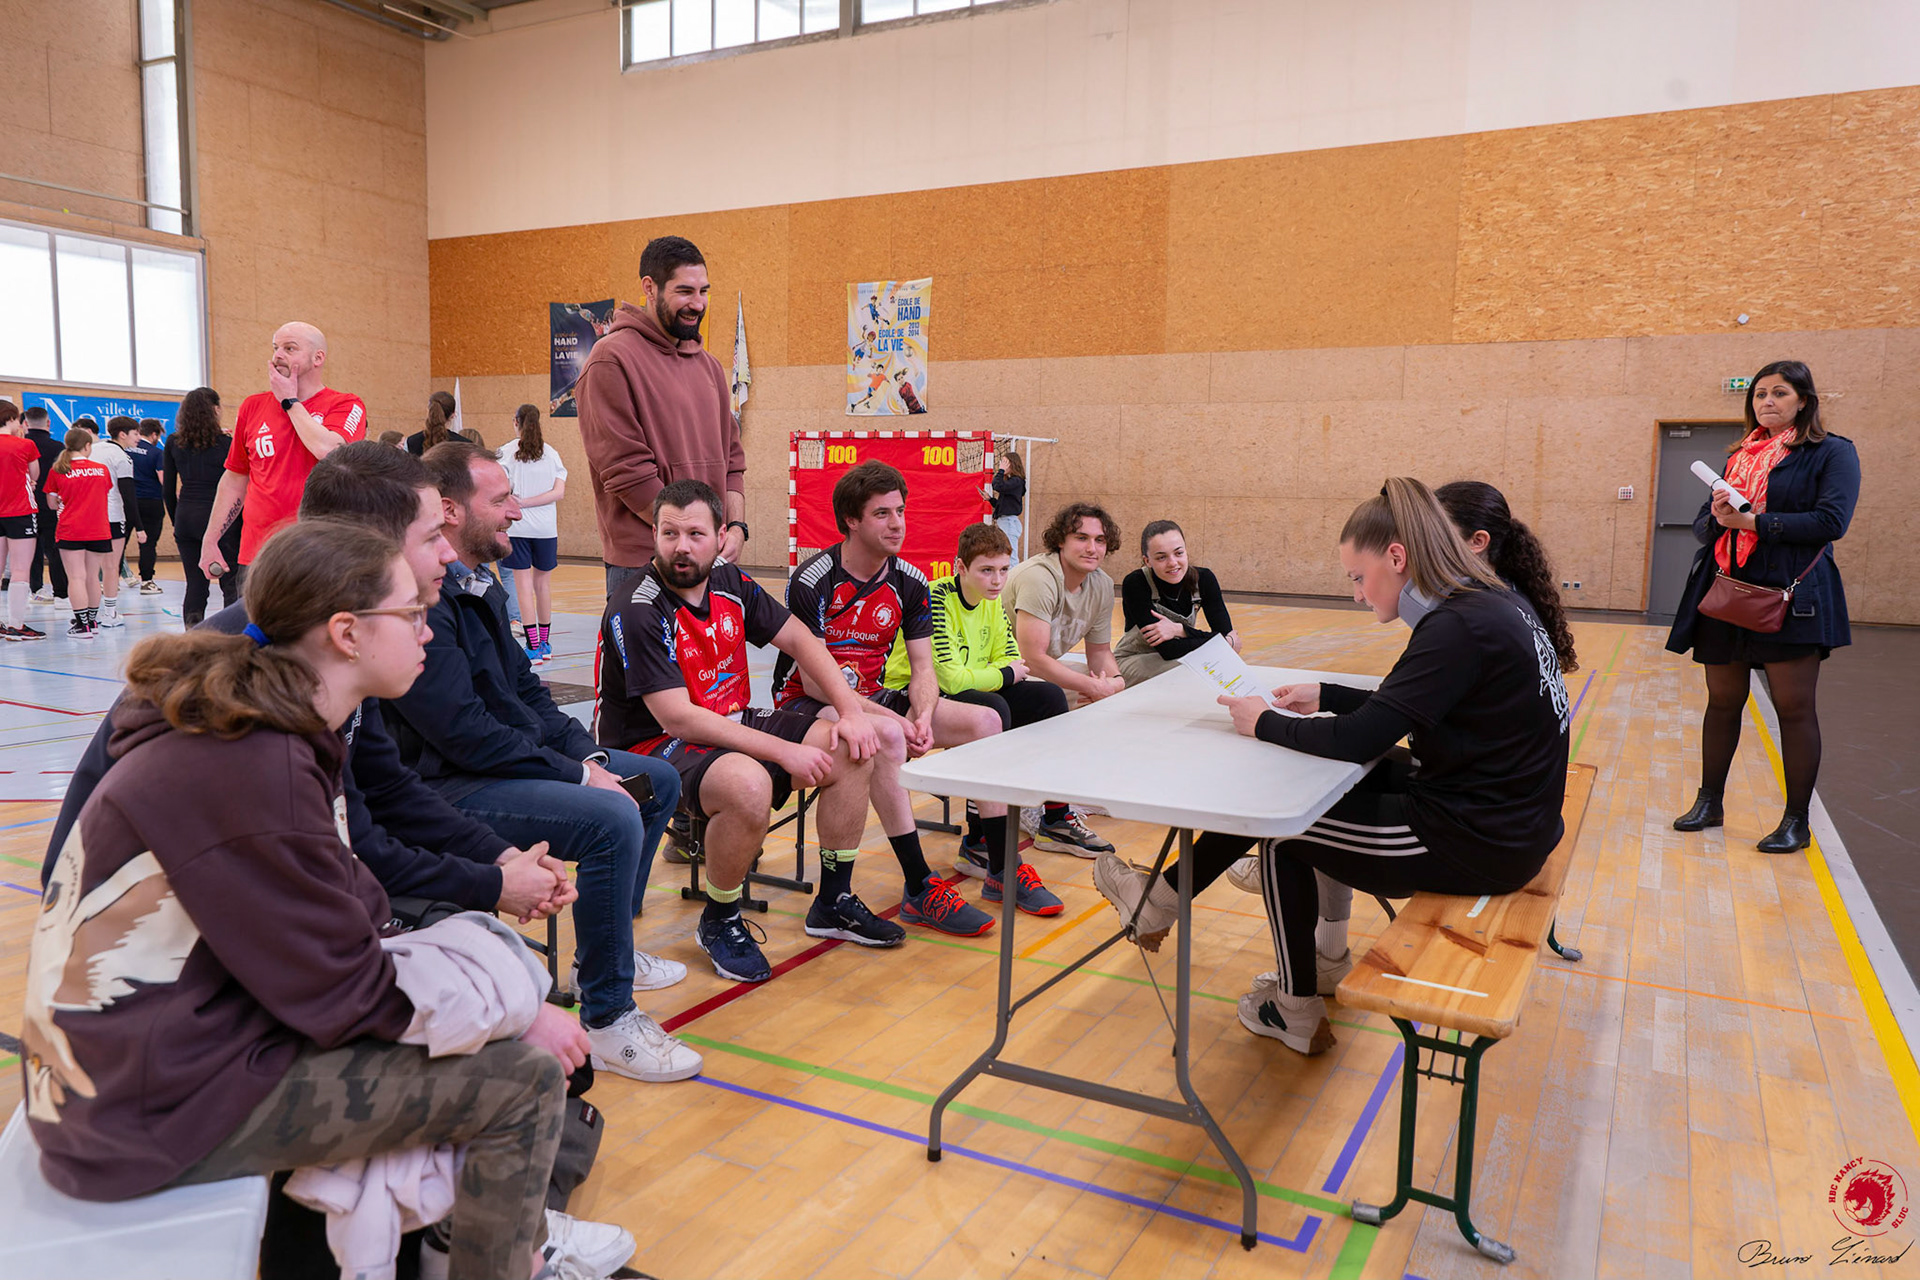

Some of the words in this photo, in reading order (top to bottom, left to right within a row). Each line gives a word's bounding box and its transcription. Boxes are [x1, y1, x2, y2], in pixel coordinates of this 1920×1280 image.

[897, 306, 921, 321] HAND
[554, 338, 578, 346] HAND
[877, 339, 889, 352] LA
[891, 338, 904, 352] VIE
[555, 352, 565, 360] LA
[97, 402, 126, 416] ville
[128, 404, 145, 416] de
[255, 434, 275, 459] 16
[827, 444, 858, 464] 100
[922, 445, 955, 466] 100
[66, 467, 105, 479] CAPUCINE
[825, 625, 845, 639] Guy
[846, 628, 880, 642] Hoquet
[698, 668, 716, 682] Guy
